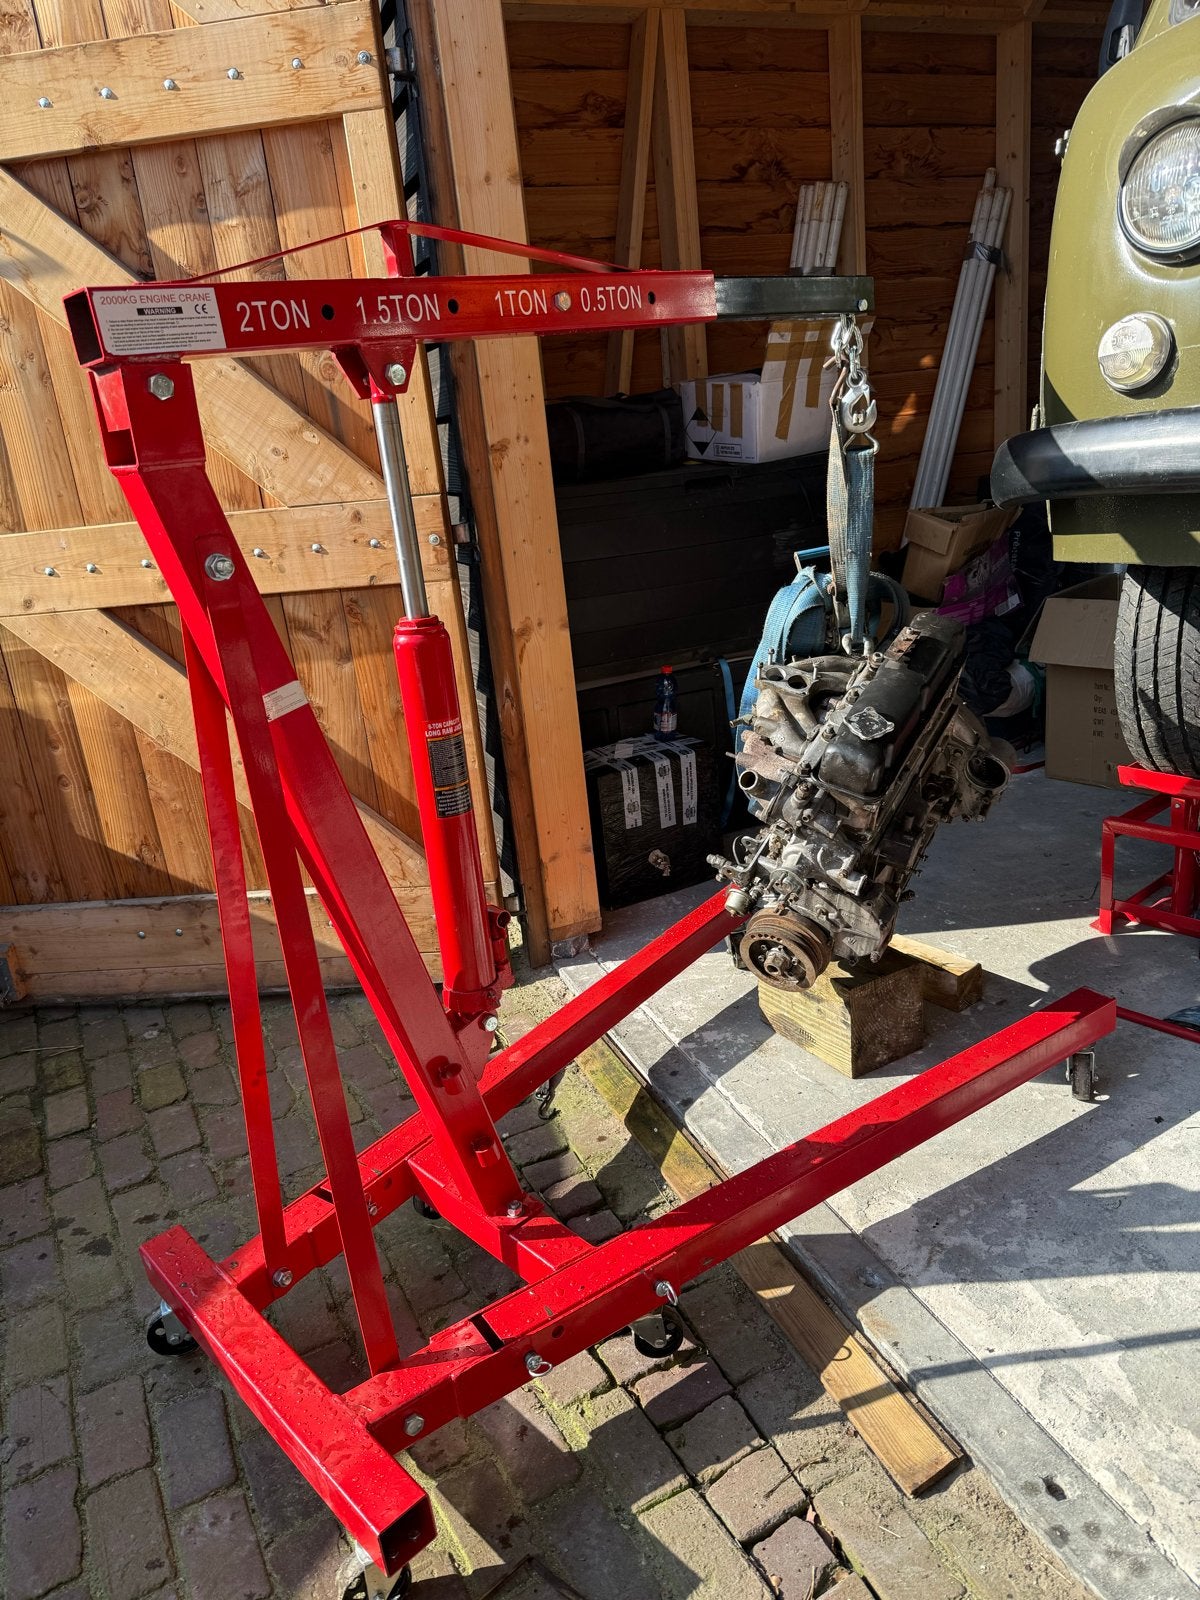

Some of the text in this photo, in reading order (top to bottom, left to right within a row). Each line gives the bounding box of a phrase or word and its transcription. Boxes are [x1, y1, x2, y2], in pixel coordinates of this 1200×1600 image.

[100, 292, 211, 306] 2000KG ENGINE CRANE
[143, 307, 177, 315] WARNING
[356, 293, 441, 325] 1.5TON
[494, 289, 548, 317] 1TON
[580, 285, 642, 313] 0.5TON
[236, 299, 311, 333] 2TON
[425, 729, 441, 737] LONG
[442, 727, 453, 735] RAM
